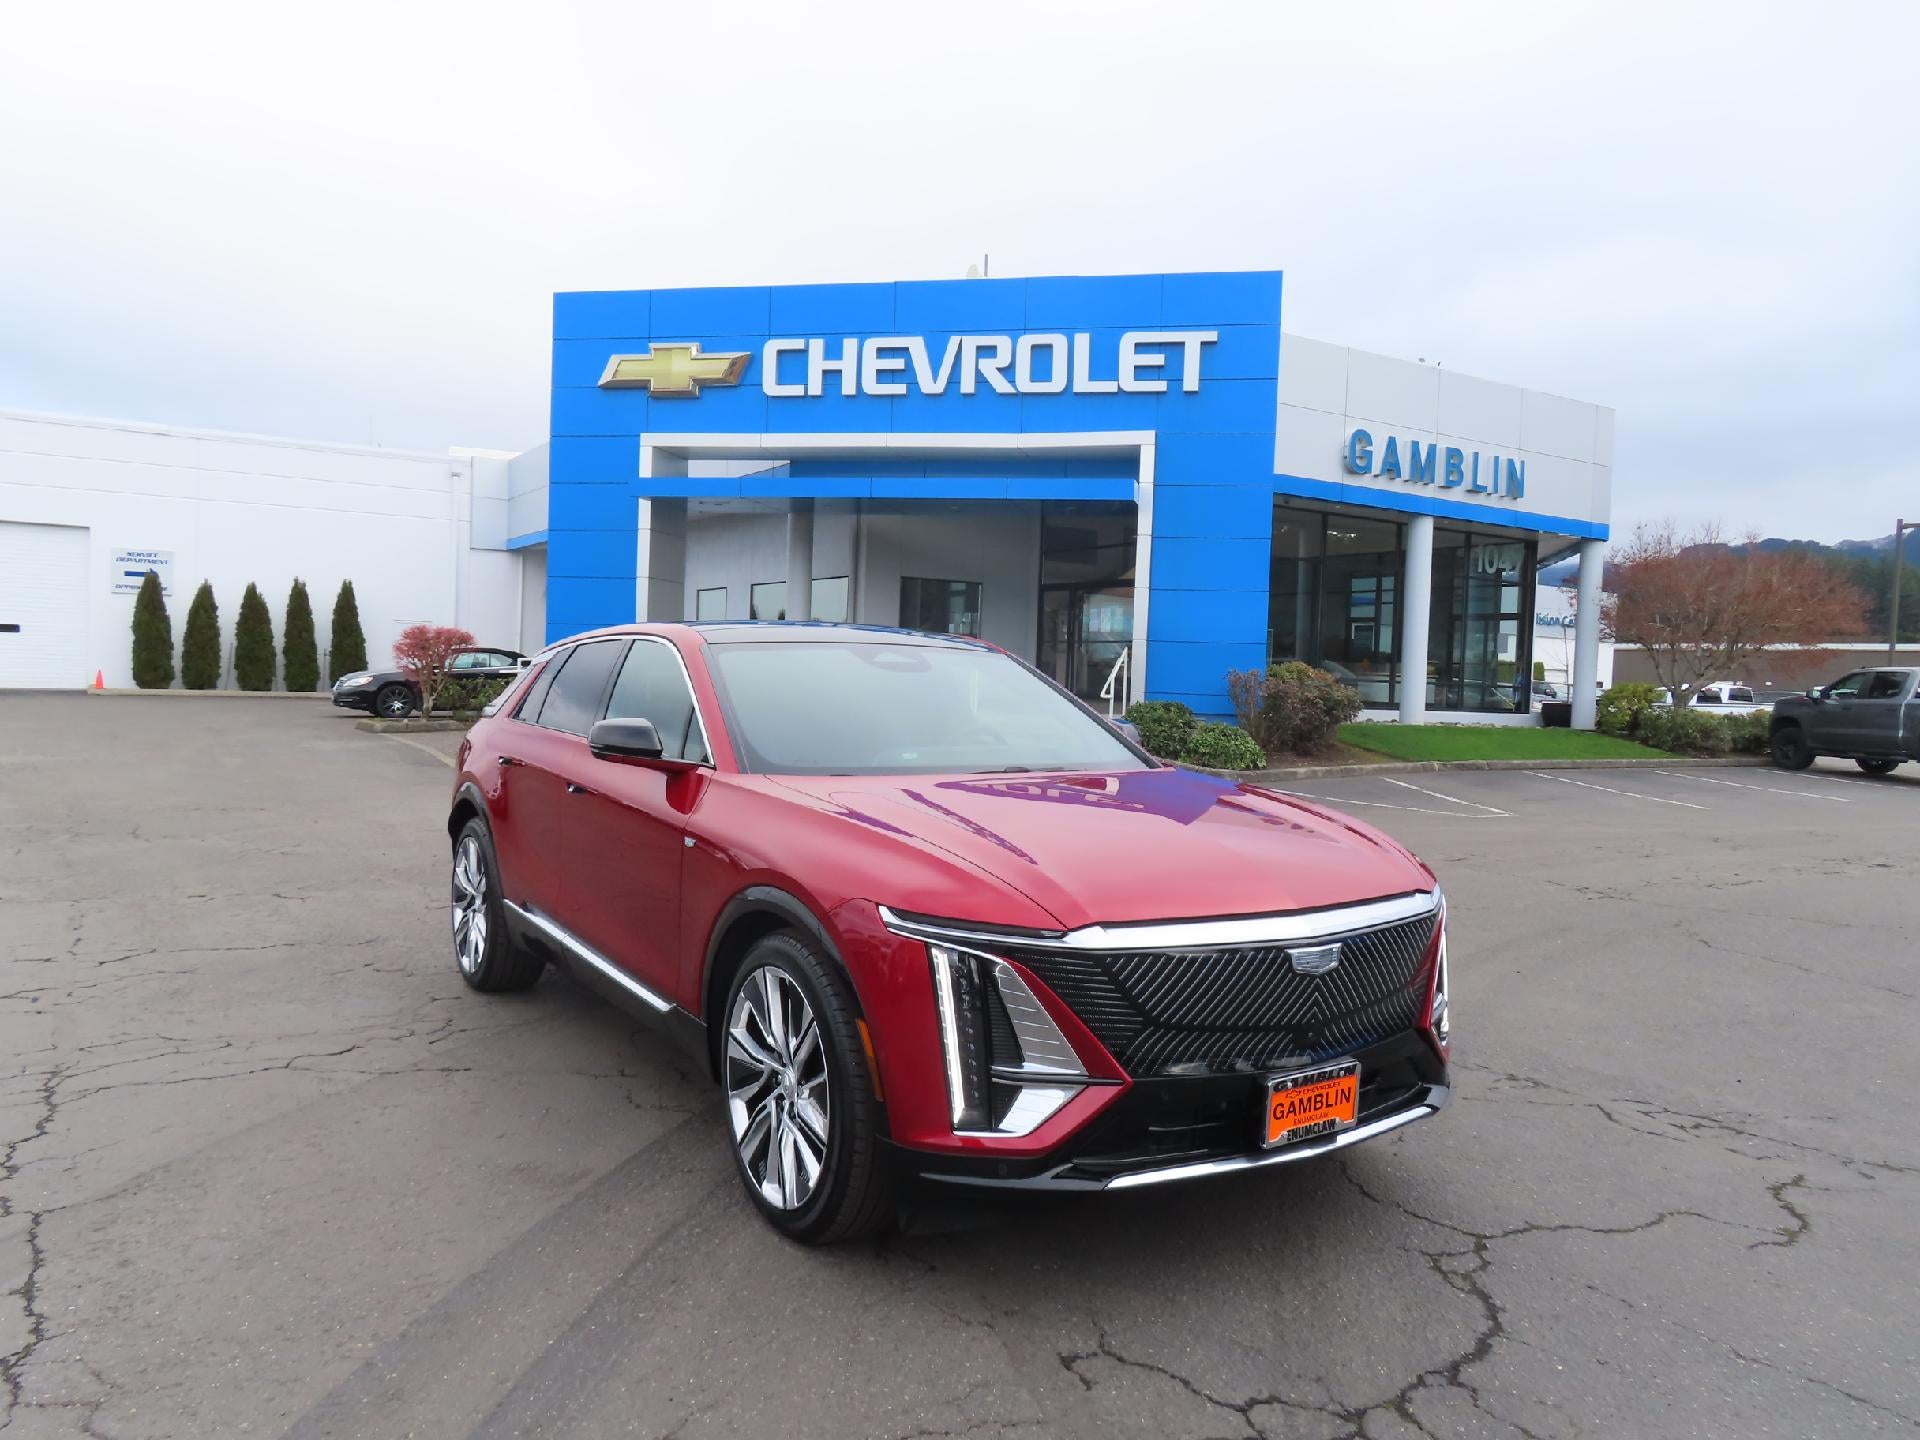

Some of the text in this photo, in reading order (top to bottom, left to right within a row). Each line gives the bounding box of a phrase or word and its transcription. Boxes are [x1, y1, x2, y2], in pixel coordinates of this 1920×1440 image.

[763, 331, 1218, 396] CHEVROLET
[1344, 429, 1525, 499] GAMBLIN
[116, 557, 168, 565] DEPARTMENT
[1536, 612, 1560, 626] lision
[1303, 1081, 1341, 1095] CHEVROLET
[1273, 1087, 1352, 1121] GAMBLIN
[1293, 1112, 1329, 1126] ENUMCLAW
[1287, 1117, 1337, 1141] ENUMCLAW
